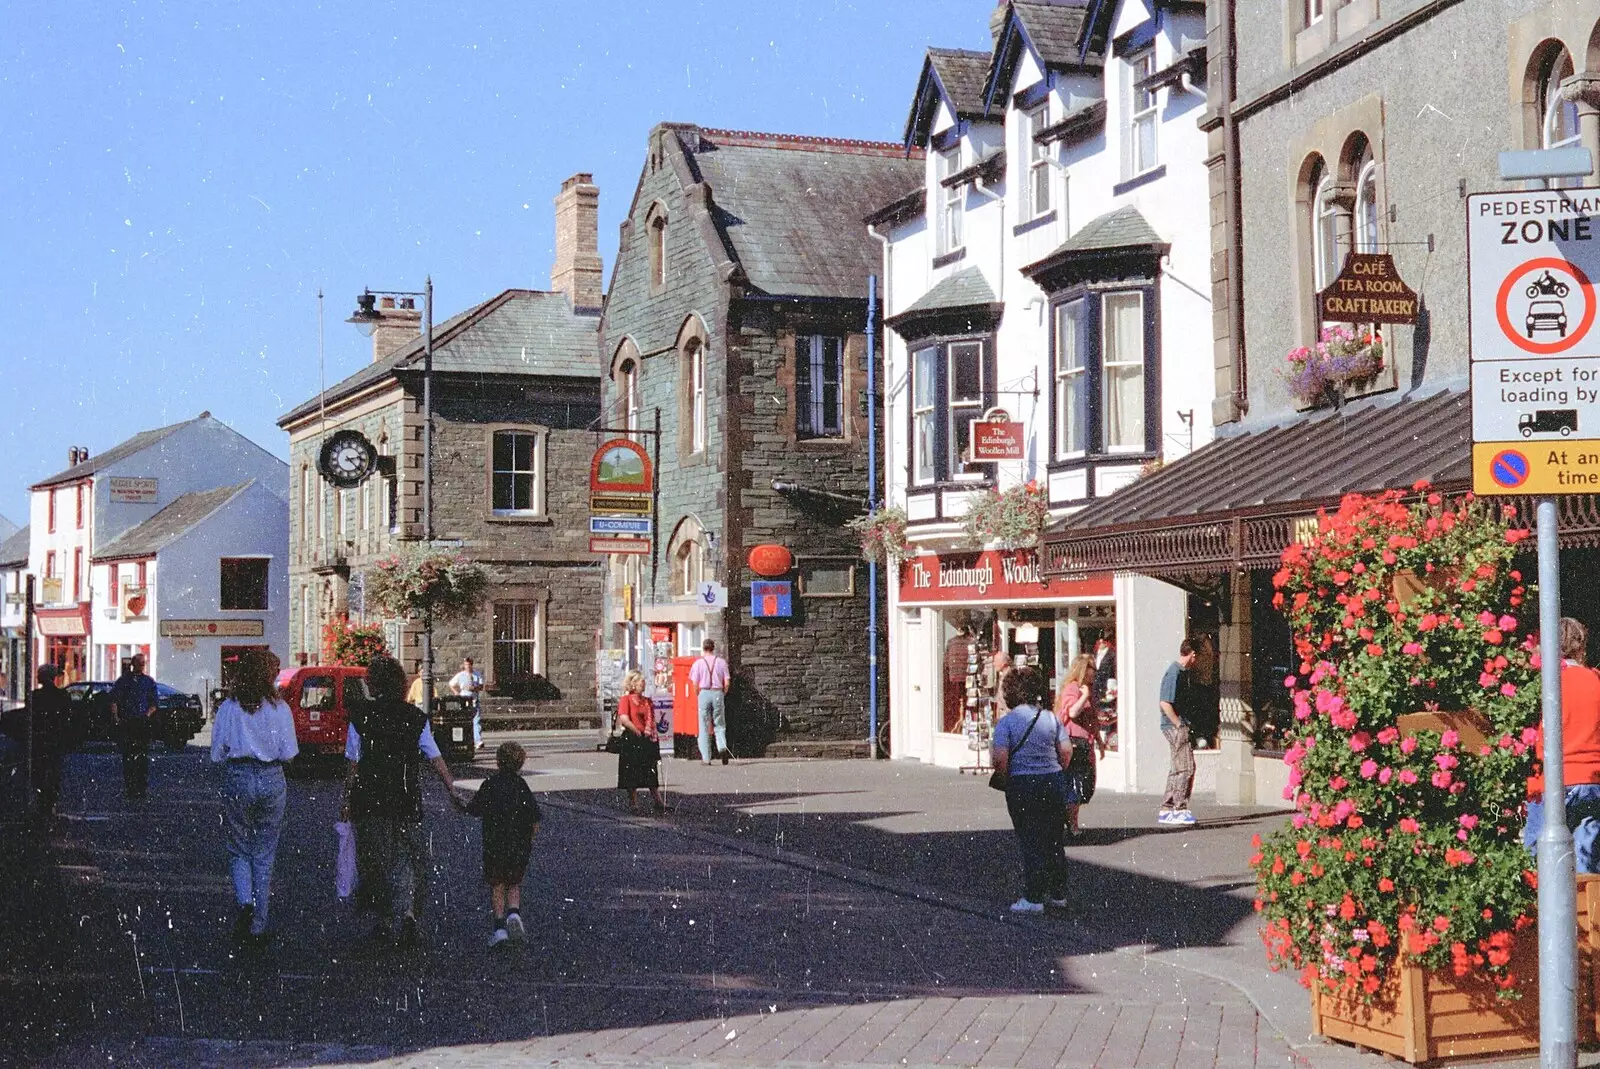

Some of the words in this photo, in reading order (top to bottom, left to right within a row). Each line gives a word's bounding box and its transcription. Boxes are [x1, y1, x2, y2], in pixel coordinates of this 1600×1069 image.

[1501, 217, 1593, 245] ZONE
[1353, 258, 1387, 275] CAFÉ
[1339, 279, 1364, 291] TEA
[1366, 280, 1403, 292] ROOM
[1326, 297, 1368, 312] CRAFT
[1370, 299, 1414, 314] BAKERY
[1500, 367, 1563, 384] Except
[1572, 366, 1598, 380] for
[1501, 385, 1569, 405] loading
[1578, 384, 1598, 403] by
[991, 427, 1006, 436] The
[981, 436, 1016, 447] Edinburgh
[978, 446, 1005, 454] Woollen
[1005, 446, 1020, 456] Mill
[1547, 451, 1568, 465] At
[1557, 470, 1598, 485] time
[762, 548, 782, 558] Post
[912, 562, 932, 588] The
[938, 556, 994, 594] Edinburgh
[1002, 556, 1044, 585] Woolle
